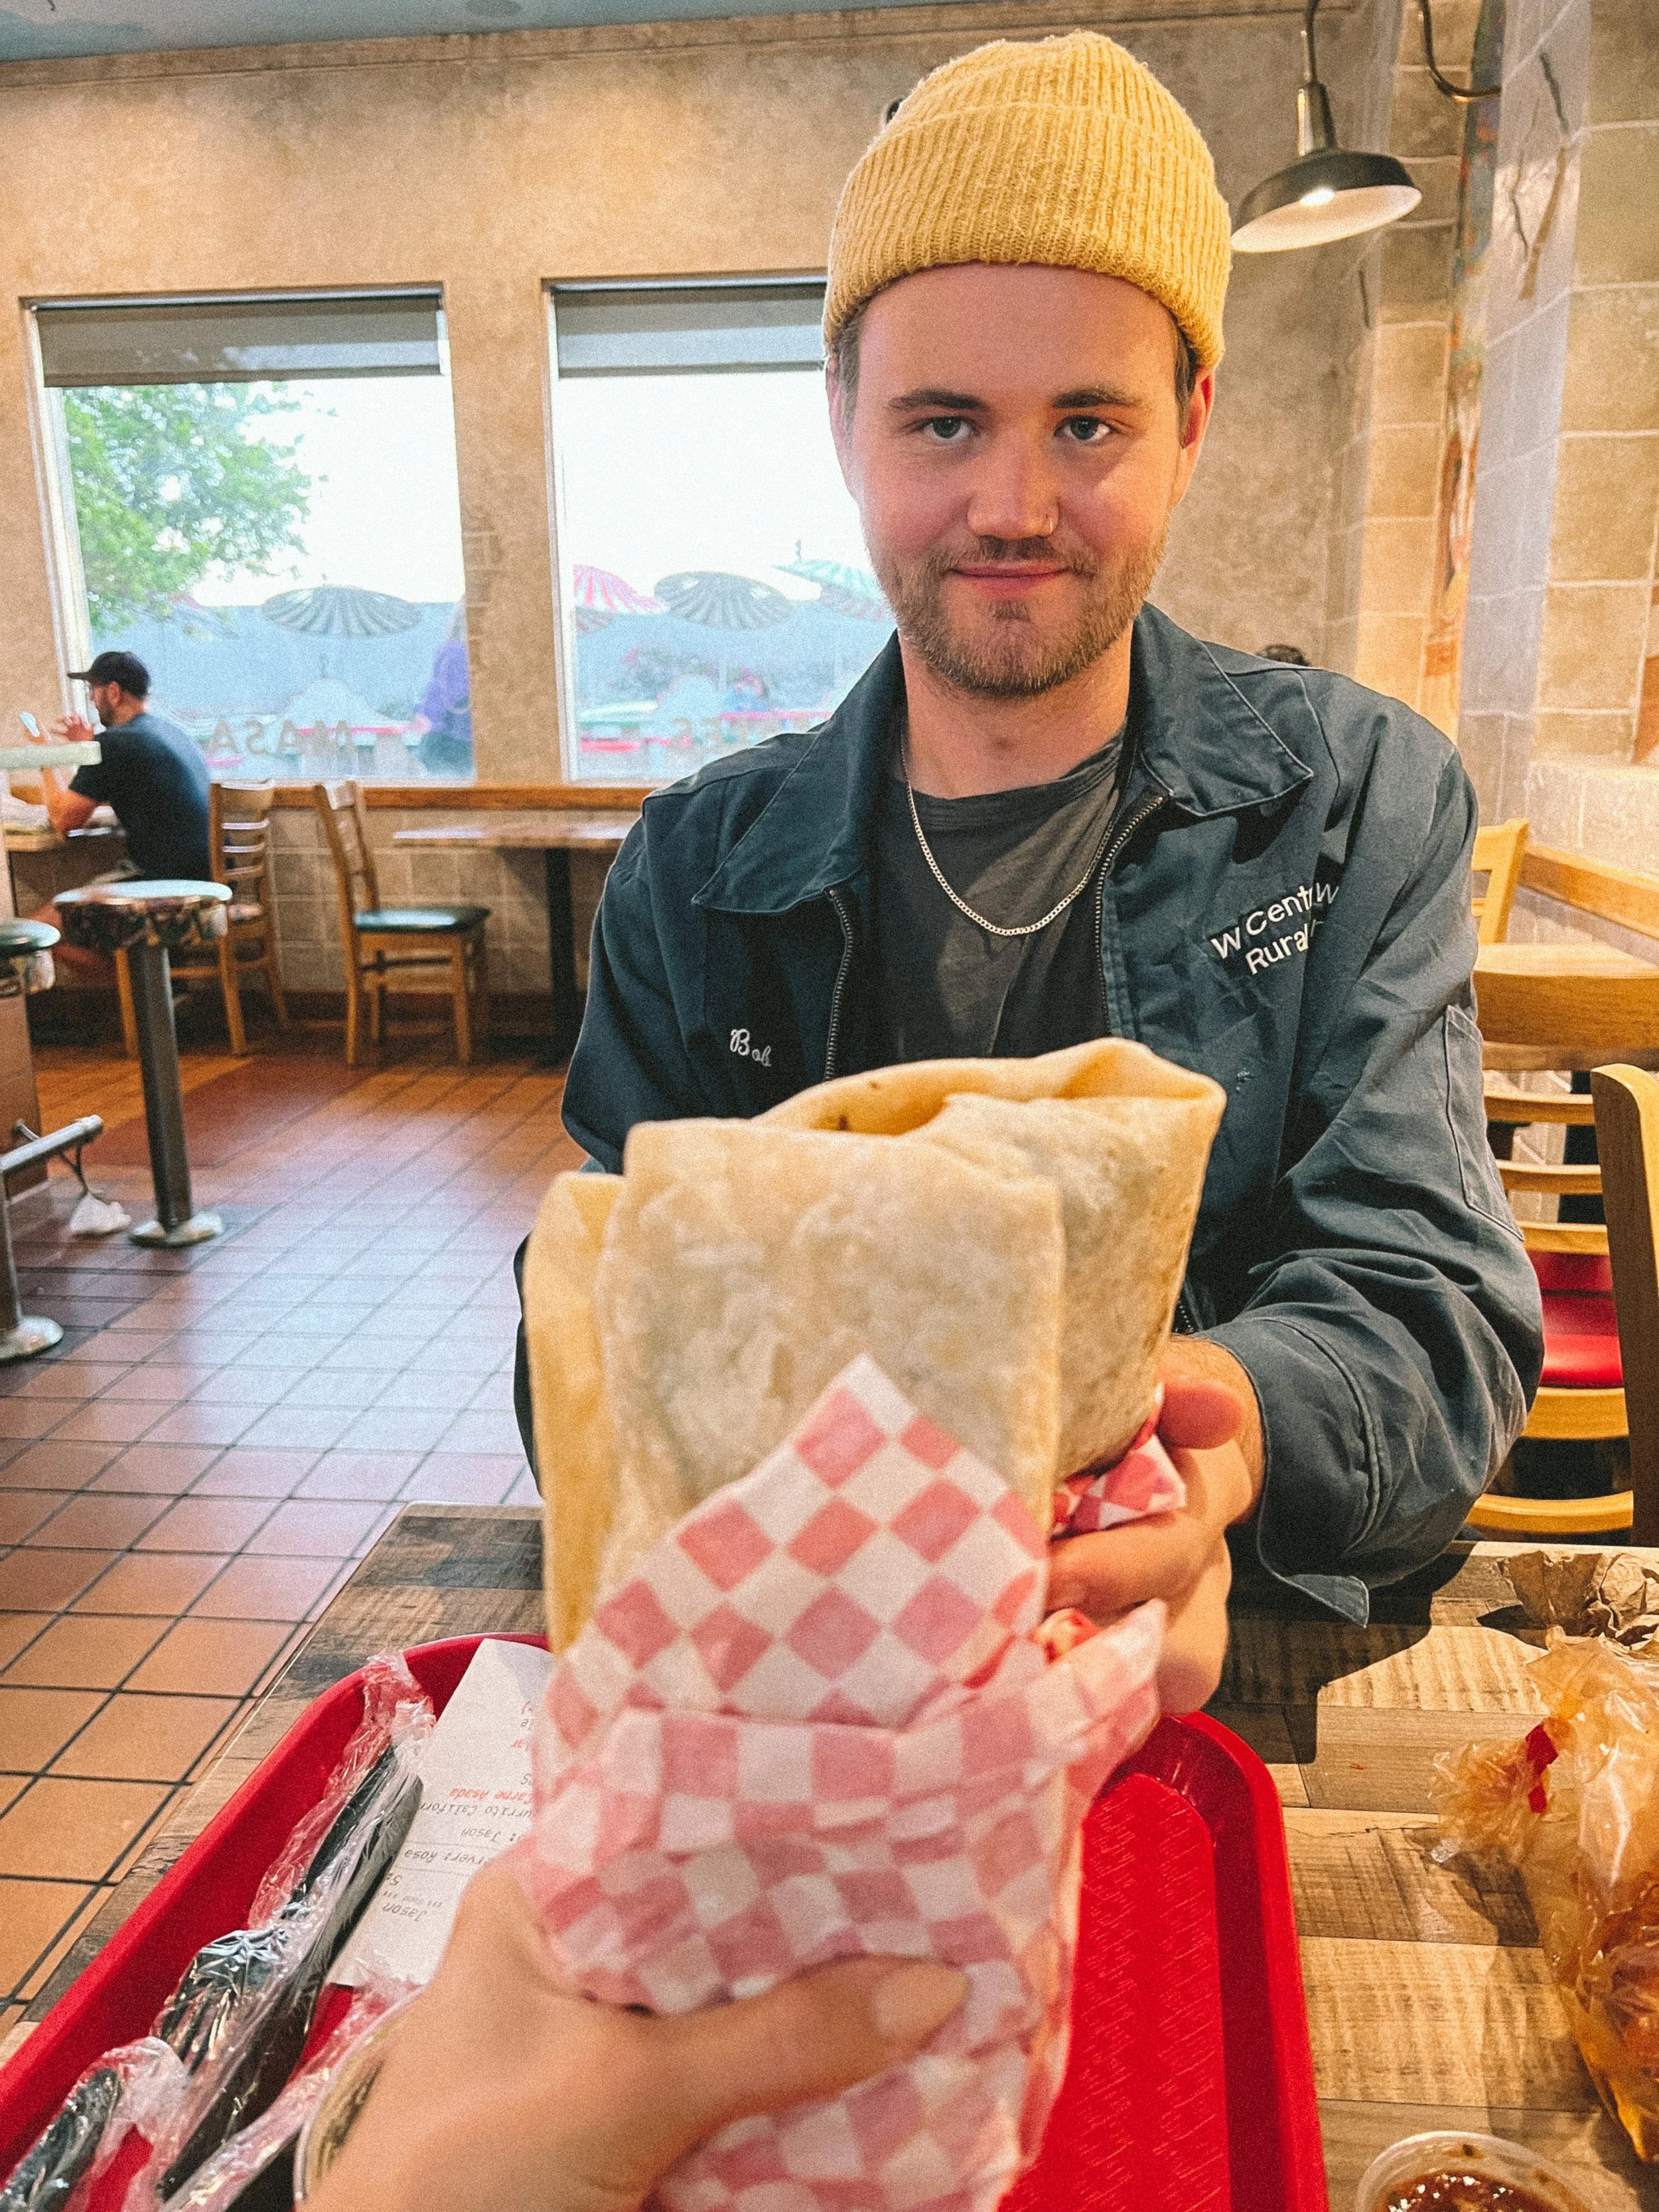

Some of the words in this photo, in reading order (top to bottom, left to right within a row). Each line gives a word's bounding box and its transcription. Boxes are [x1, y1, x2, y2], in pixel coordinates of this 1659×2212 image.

[449, 1788, 489, 1801] Asada
[485, 1805, 533, 1819] urrito
[461, 1828, 501, 1842] Jason
[404, 1849, 437, 1864] Rosa
[444, 1852, 485, 1866] rver:
[382, 1903, 427, 1922] Jason
